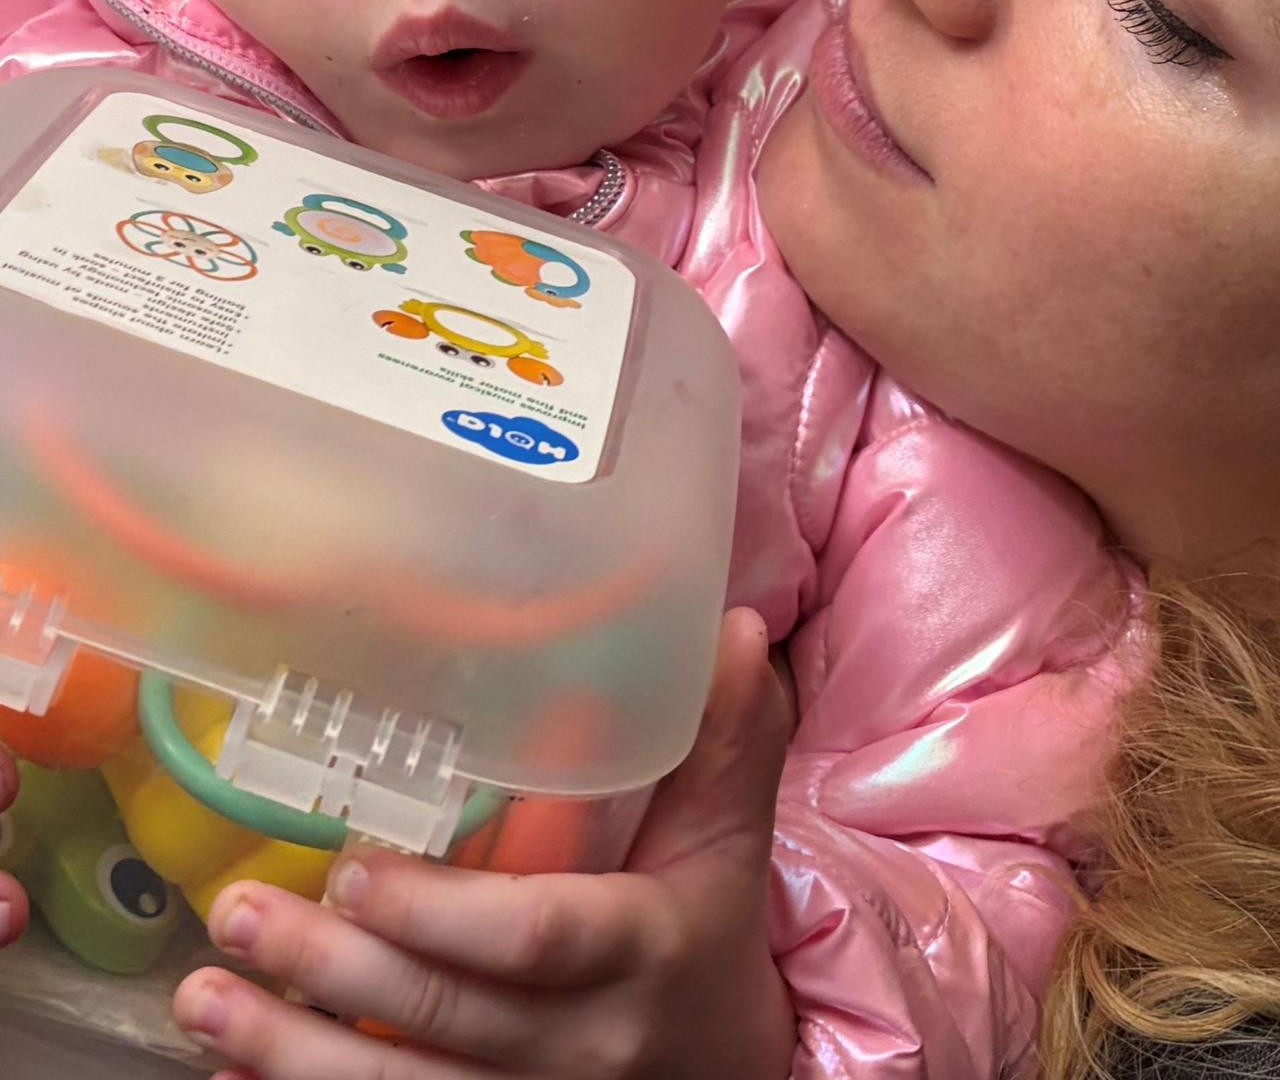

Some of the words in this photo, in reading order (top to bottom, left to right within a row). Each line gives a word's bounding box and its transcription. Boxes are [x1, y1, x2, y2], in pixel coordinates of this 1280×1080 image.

[18, 250, 59, 269] using
[52, 247, 68, 256] in
[72, 253, 107, 269] soak
[1, 262, 61, 287] musical
[62, 267, 82, 278] by
[93, 253, 152, 277] minutes
[63, 286, 82, 294] of
[78, 264, 160, 297] technology
[85, 275, 130, 294] made
[122, 272, 186, 297] disinfect
[169, 281, 190, 292] for
[72, 296, 126, 318] shapes
[86, 292, 139, 314] sounds
[146, 296, 197, 318] design
[190, 295, 205, 305] to
[194, 288, 246, 311] boiling
[164, 295, 238, 324] ultrasonic
[209, 303, 243, 318] Easy
[129, 316, 175, 335] about
[143, 313, 168, 326] the
[200, 316, 234, 332] Safe
[377, 352, 455, 383] awareness
[439, 367, 475, 383] skills
[459, 381, 516, 405] musical
[479, 381, 522, 399] motor
[526, 397, 554, 411] fine
[519, 402, 586, 430] Improves
[558, 408, 588, 421] and
